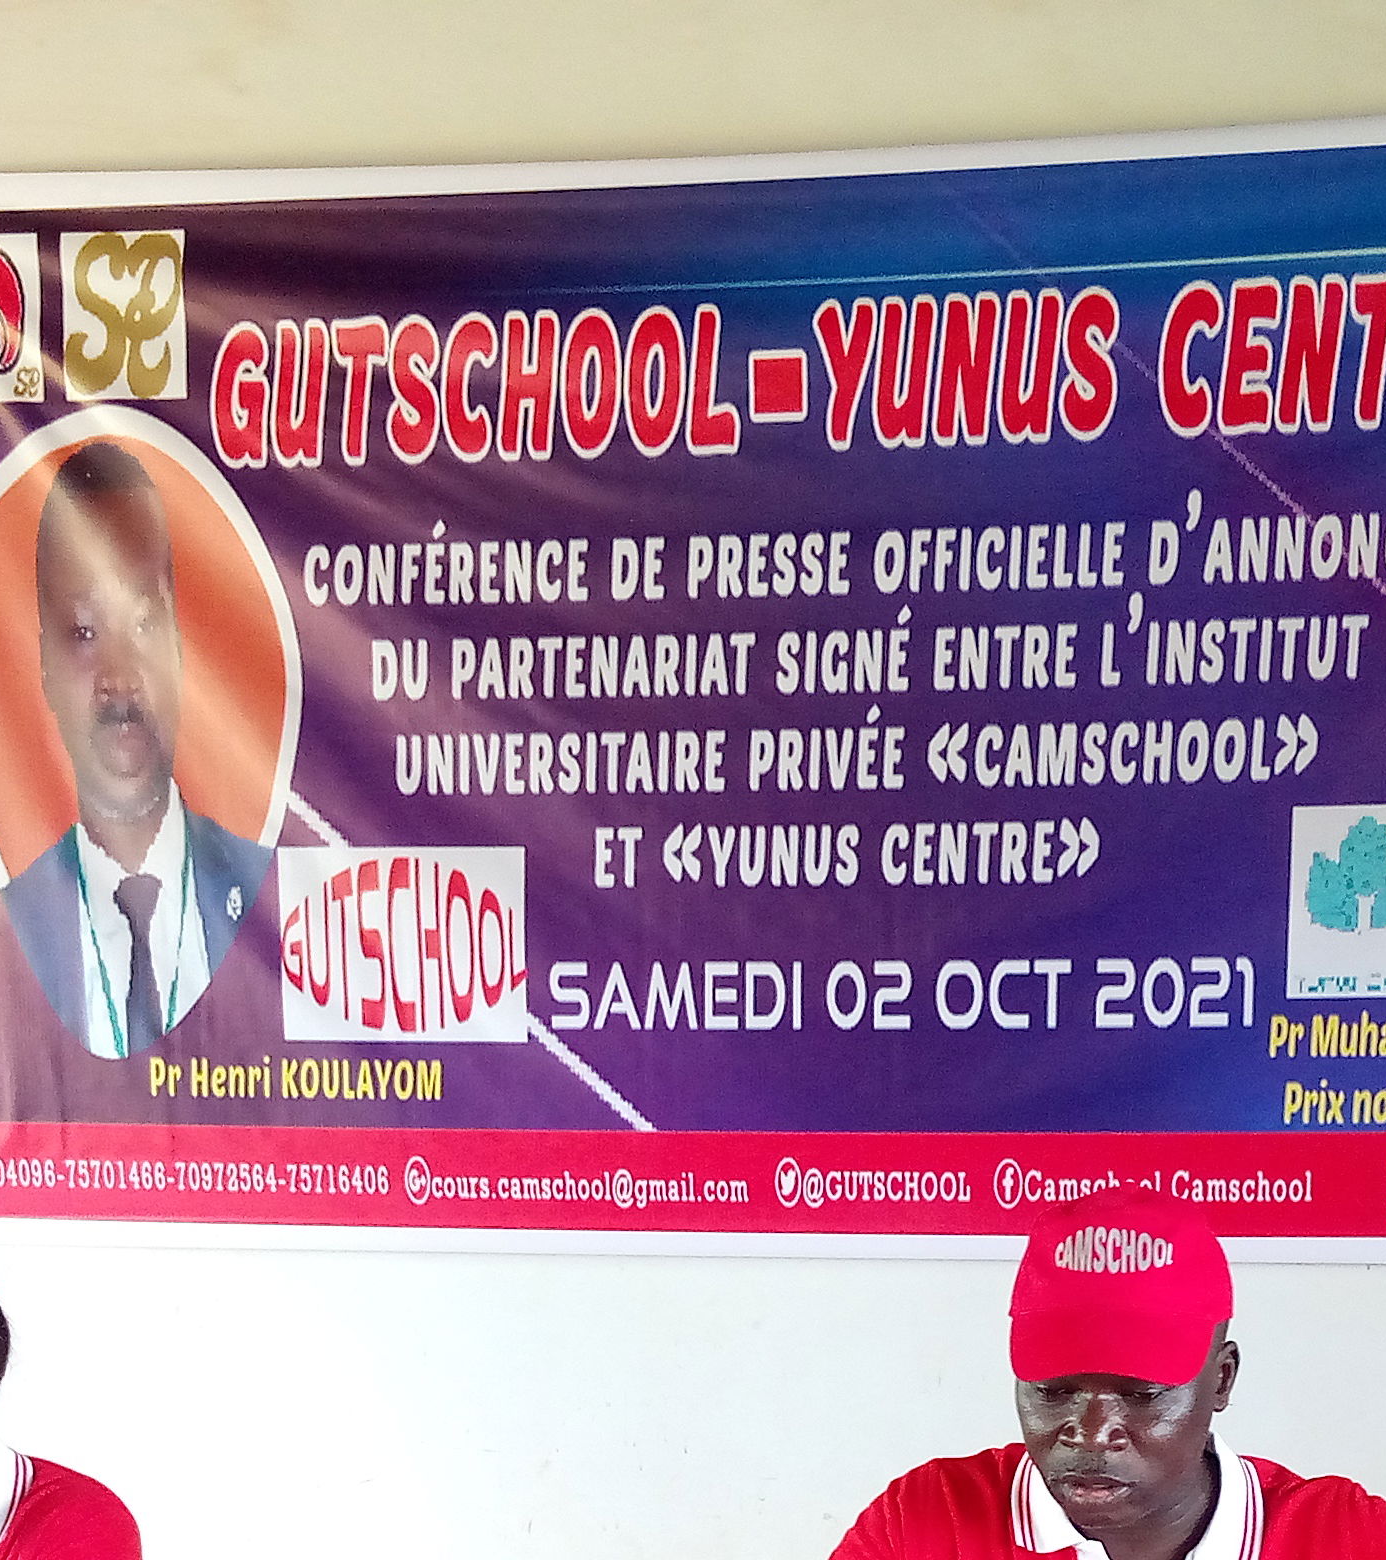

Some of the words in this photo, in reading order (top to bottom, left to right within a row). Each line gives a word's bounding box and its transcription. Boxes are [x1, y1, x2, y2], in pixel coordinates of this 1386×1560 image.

[303, 519, 590, 607] CONFÉRENCE
[612, 536, 665, 601] DE
[687, 530, 851, 600] PRESSE
[873, 520, 1126, 596] OFFICIELLE
[371, 638, 429, 701] DU
[451, 631, 756, 699] PARTENARIAT
[775, 604, 911, 697] SIGNÉ
[933, 622, 1078, 691] ENTRE
[1100, 591, 1370, 690] L'INSTITUT
[394, 728, 727, 797] UNIVERSITAIRE
[748, 703, 906, 793] PRIVÉE
[593, 825, 643, 889] ET
[280, 855, 528, 1034] GUTSCHOOL
[548, 960, 804, 1032] SAMEDI
[825, 958, 913, 1032] 02
[934, 957, 1073, 1031] OCT
[1093, 955, 1256, 1030] 2021
[1269, 1014, 1306, 1059] Pr
[149, 1056, 183, 1098] Pr
[190, 1055, 272, 1098] Henri
[281, 1058, 443, 1100] KOULAYOM
[1283, 1079, 1345, 1127] Prix
[431, 1168, 750, 1209] cours.camschool@gmail.com
[802, 1168, 971, 1208] @GUTSCHOOL
[1171, 1170, 1313, 1203] Camschool
[1054, 1226, 1173, 1274] CAMSCHOOL
